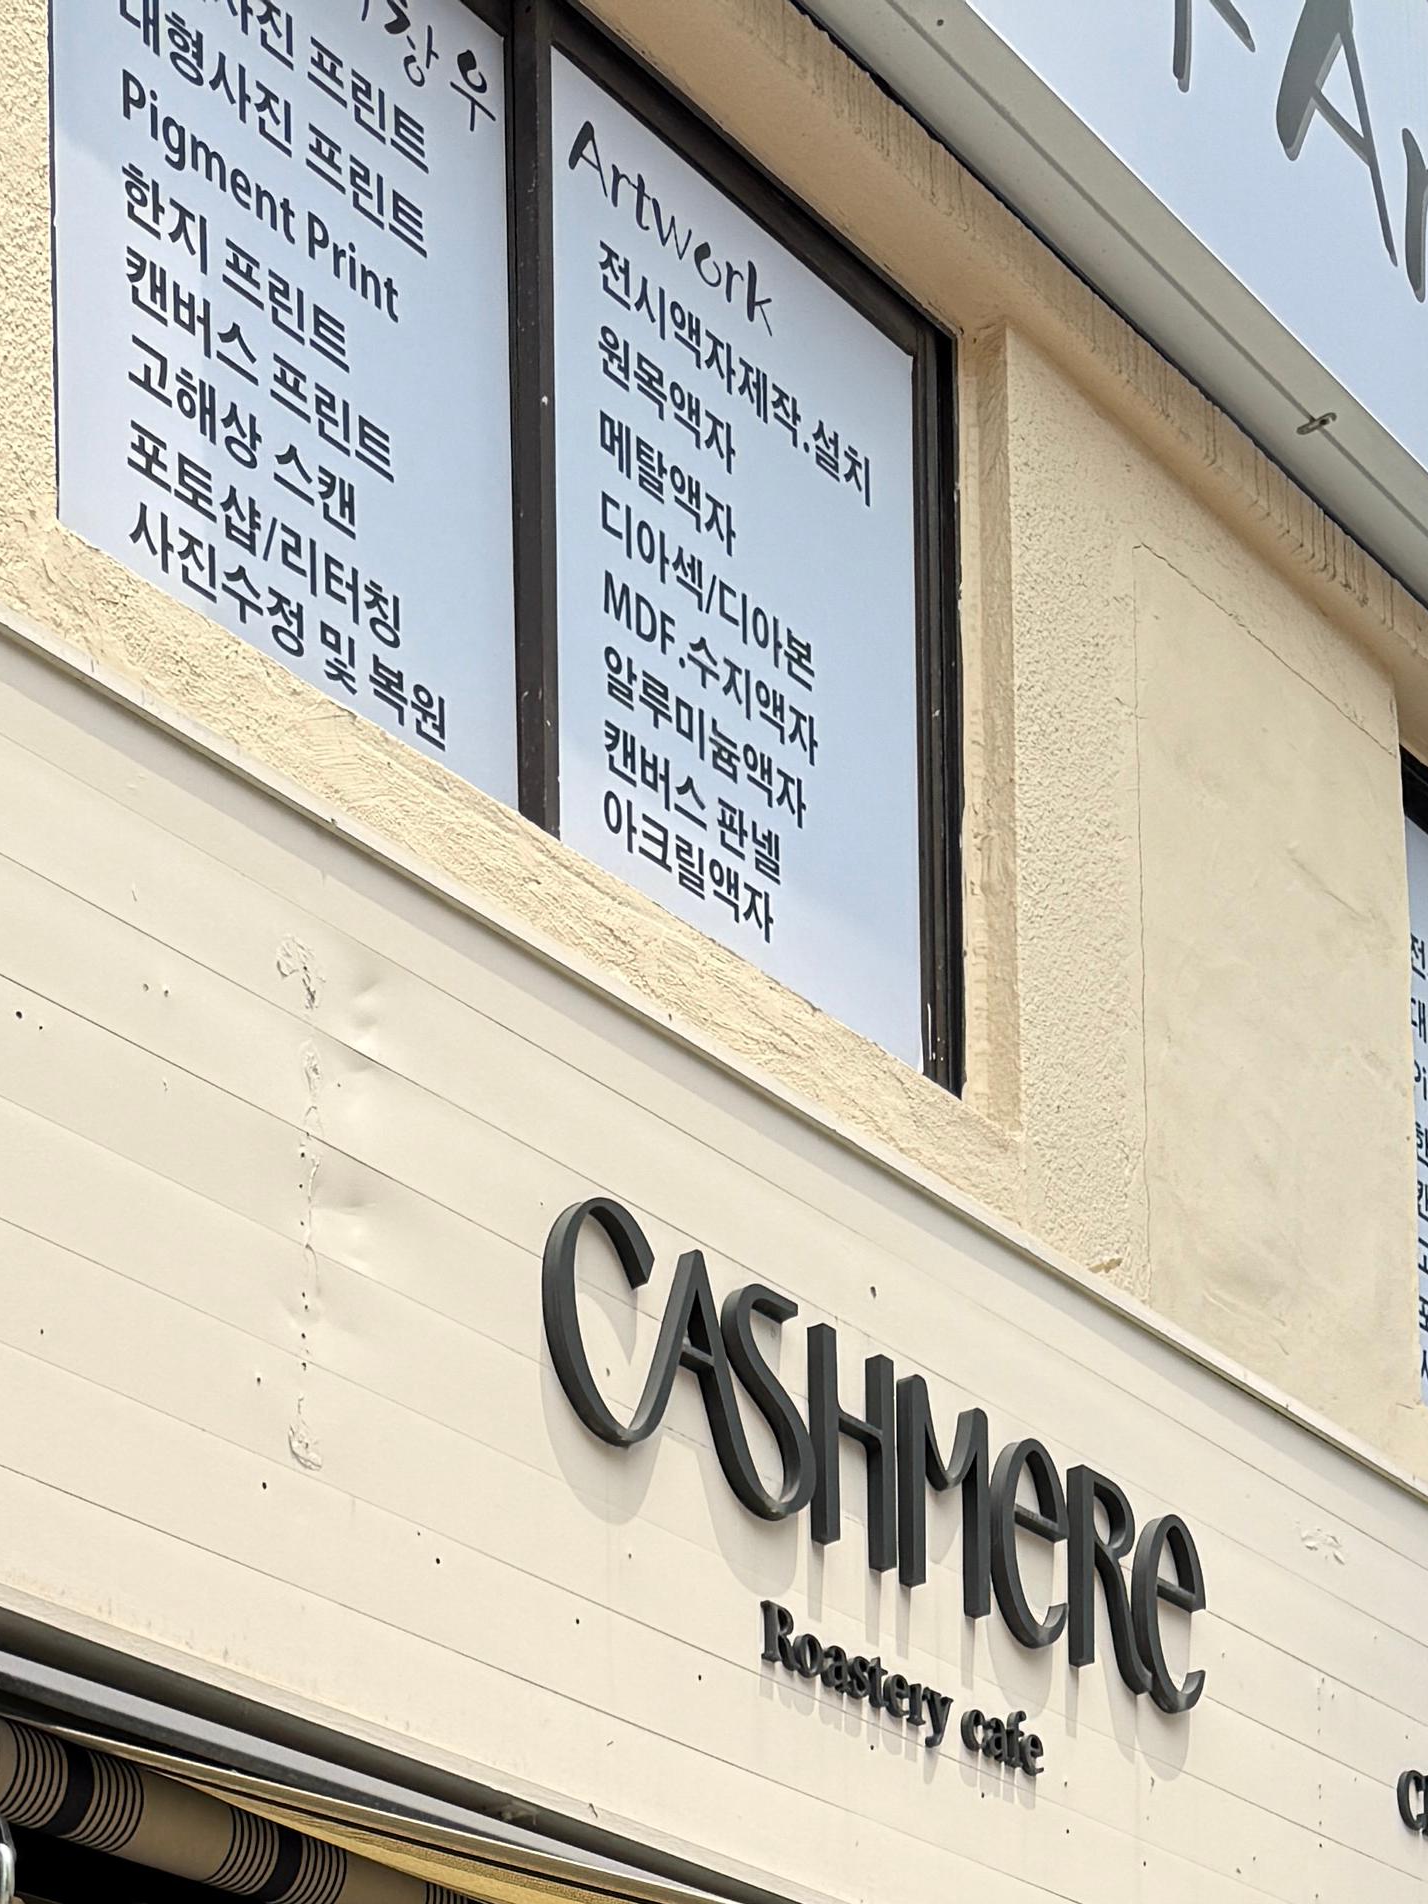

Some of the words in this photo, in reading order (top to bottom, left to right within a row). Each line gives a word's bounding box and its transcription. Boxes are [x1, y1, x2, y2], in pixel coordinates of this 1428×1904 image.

[118, 0, 292, 158] 대형사진
[305, 121, 427, 258] 프린트
[307, 36, 429, 174] 프린트
[361, 0, 496, 132] 창우
[121, 161, 208, 275] 한지
[222, 237, 349, 373] 프린트
[122, 68, 296, 246] Pigment
[308, 213, 399, 322] Print
[567, 120, 775, 337] Artwork
[124, 246, 258, 386] 캔버스
[269, 351, 394, 483] 프린트
[128, 333, 261, 469] 고해상
[274, 445, 357, 540] 스캔
[597, 239, 872, 507] 전시액자제작.설치
[598, 322, 737, 474] 원목액자
[126, 419, 401, 651] 포토샵/리터칭
[599, 408, 737, 557] 메탈액자
[130, 502, 304, 658] 사진수정
[319, 617, 358, 695] 및
[368, 654, 446, 752] 복원
[599, 491, 816, 693] 디아섹/디아본
[603, 570, 820, 766] MDF.수지액자
[603, 643, 808, 830] 알루미늄액자
[603, 719, 707, 828] 캔버스
[716, 797, 783, 886] 판넬
[603, 789, 775, 947] 아크릴액자
[541, 1194, 1209, 1715] CASHMERE
[760, 1598, 953, 1751] Roastery
[959, 1698, 1046, 1777] cafe
